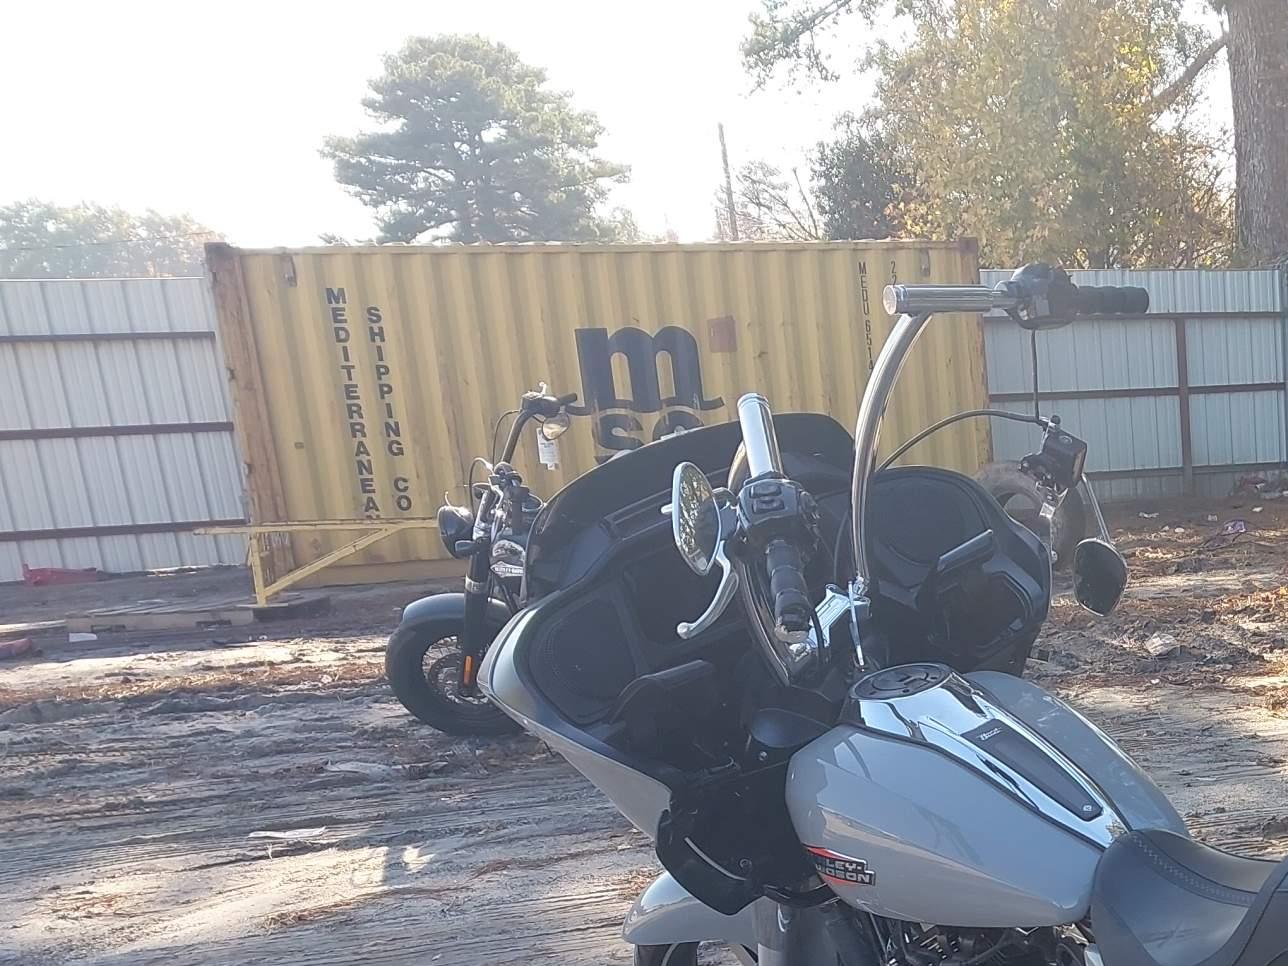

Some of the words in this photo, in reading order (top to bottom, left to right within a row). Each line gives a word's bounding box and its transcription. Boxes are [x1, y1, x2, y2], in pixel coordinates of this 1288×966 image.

[326, 287, 380, 519] MEDITERRANEA
[366, 306, 405, 457] SHIPPING
[393, 476, 412, 511] CO
